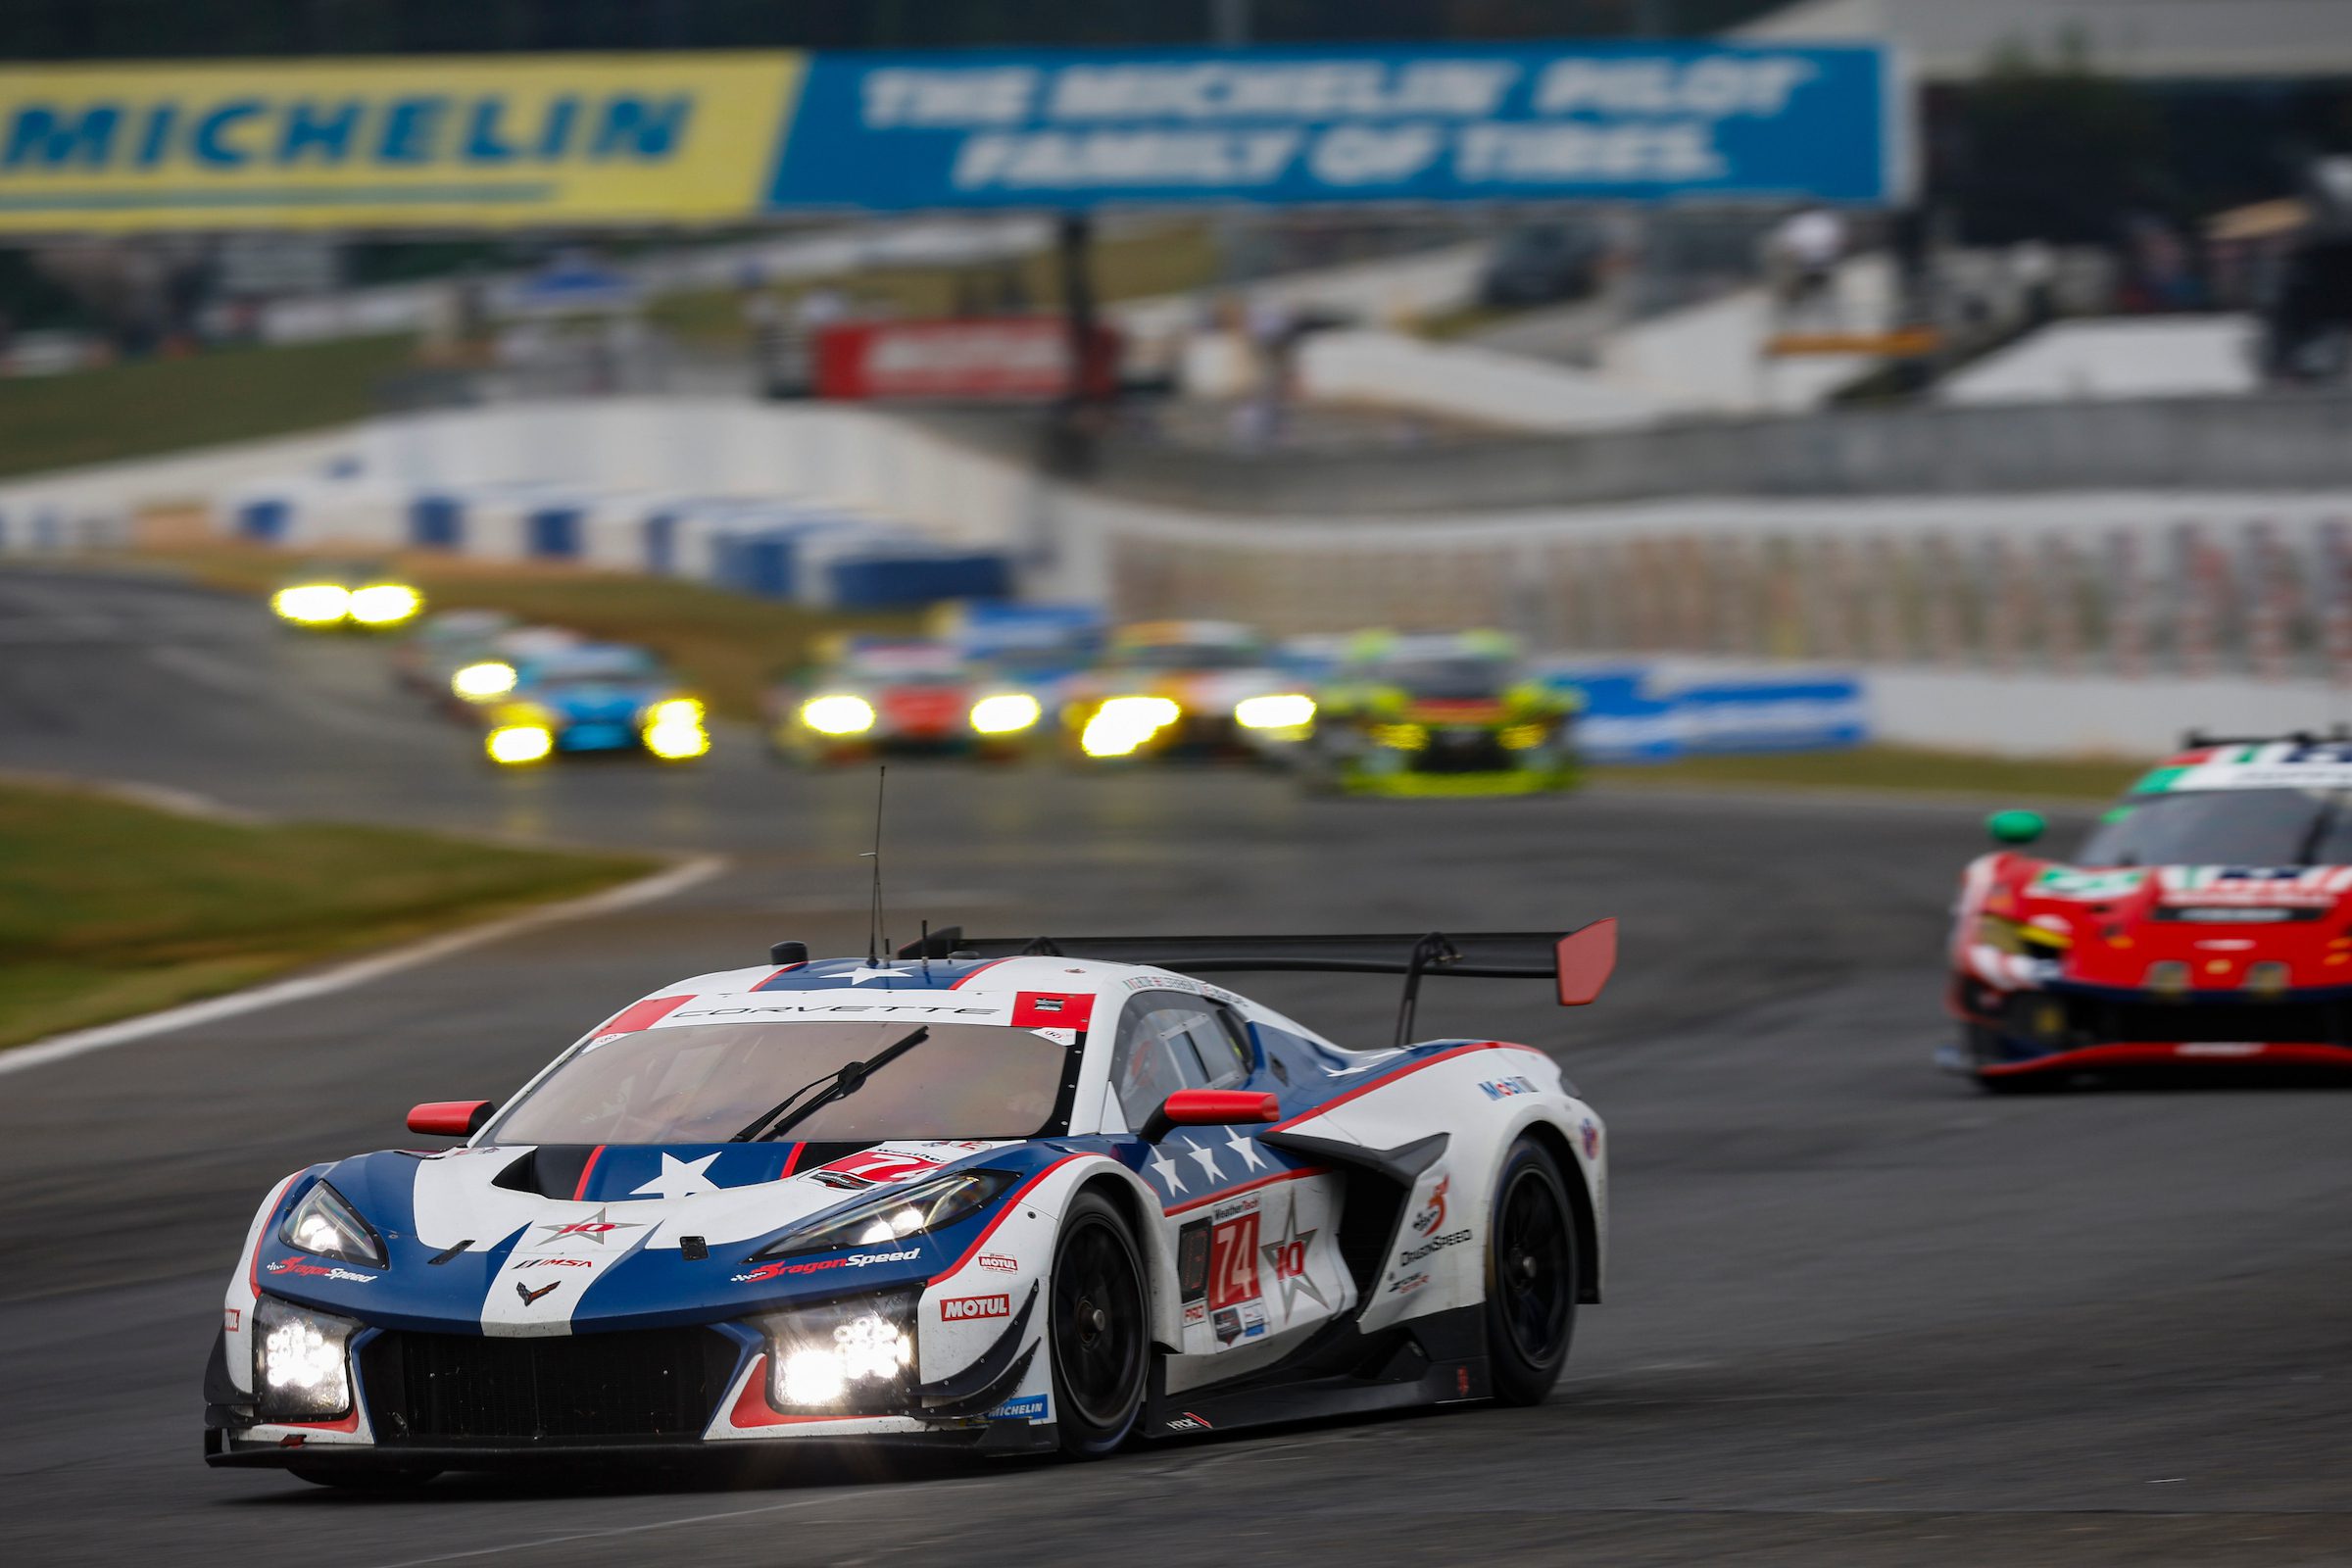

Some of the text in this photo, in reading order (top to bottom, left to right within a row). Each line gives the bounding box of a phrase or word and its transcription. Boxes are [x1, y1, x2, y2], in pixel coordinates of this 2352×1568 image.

[860, 57, 1819, 127] THE MICHELIN PILOT
[2, 90, 696, 171] MICHELIN
[951, 125, 1299, 186] FAMILY
[1306, 123, 1448, 184] OF
[672, 1004, 1002, 1018] CORVETTE
[559, 1223, 615, 1234] 10
[981, 1257, 1017, 1270] MOTUL
[1217, 1220, 1252, 1303] 74
[1277, 1241, 1305, 1282] 10
[946, 1298, 1007, 1317] MOTUL
[989, 1402, 1043, 1417] MICHELIN
